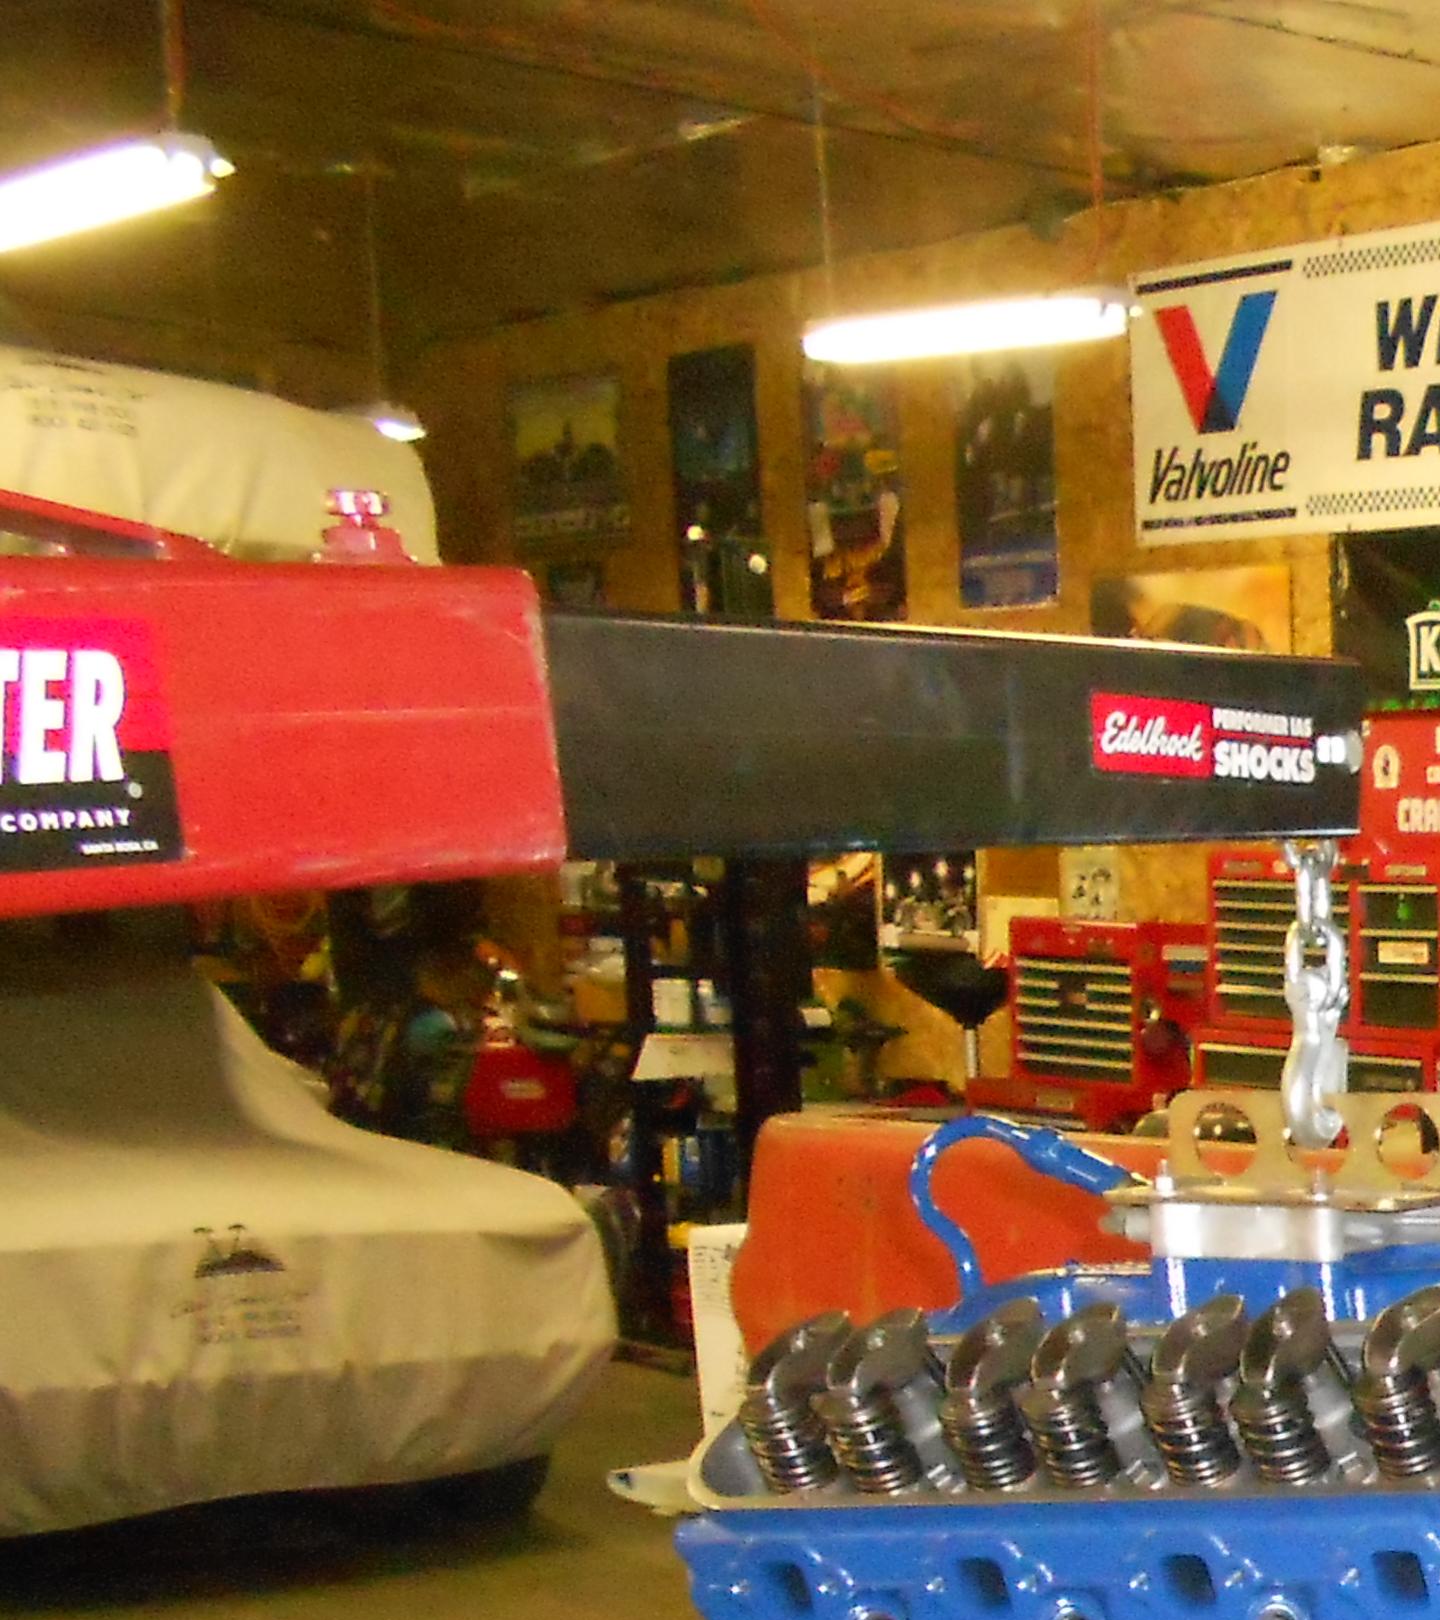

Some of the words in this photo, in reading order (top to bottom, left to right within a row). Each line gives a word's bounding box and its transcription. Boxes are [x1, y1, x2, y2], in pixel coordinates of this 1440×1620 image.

[1148, 441, 1291, 505] Valvoline
[1100, 710, 1205, 762] Edelbrock
[1212, 739, 1316, 784] SHOCKS
[0, 808, 131, 833] COMPANY
